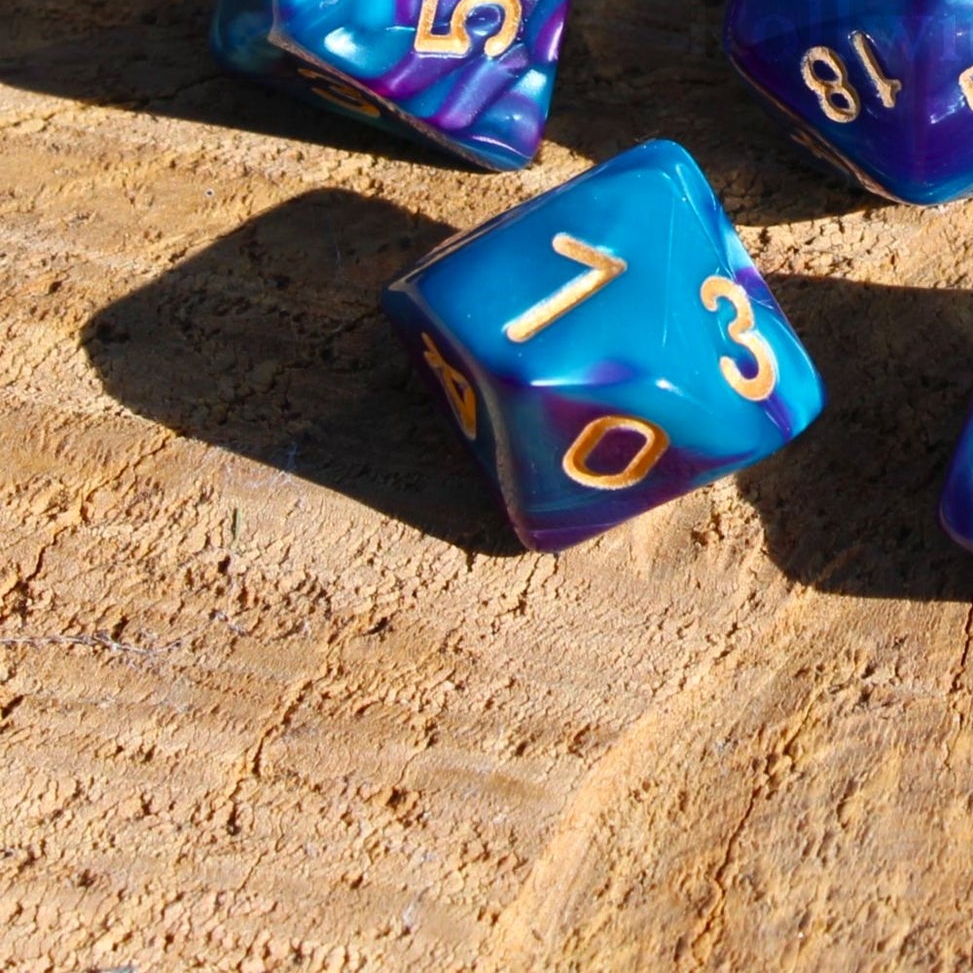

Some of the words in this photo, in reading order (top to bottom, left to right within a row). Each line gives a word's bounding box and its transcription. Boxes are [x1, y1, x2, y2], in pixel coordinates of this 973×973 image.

[801, 30, 902, 123] 18
[700, 276, 778, 402] 3
[563, 415, 671, 491] 0
